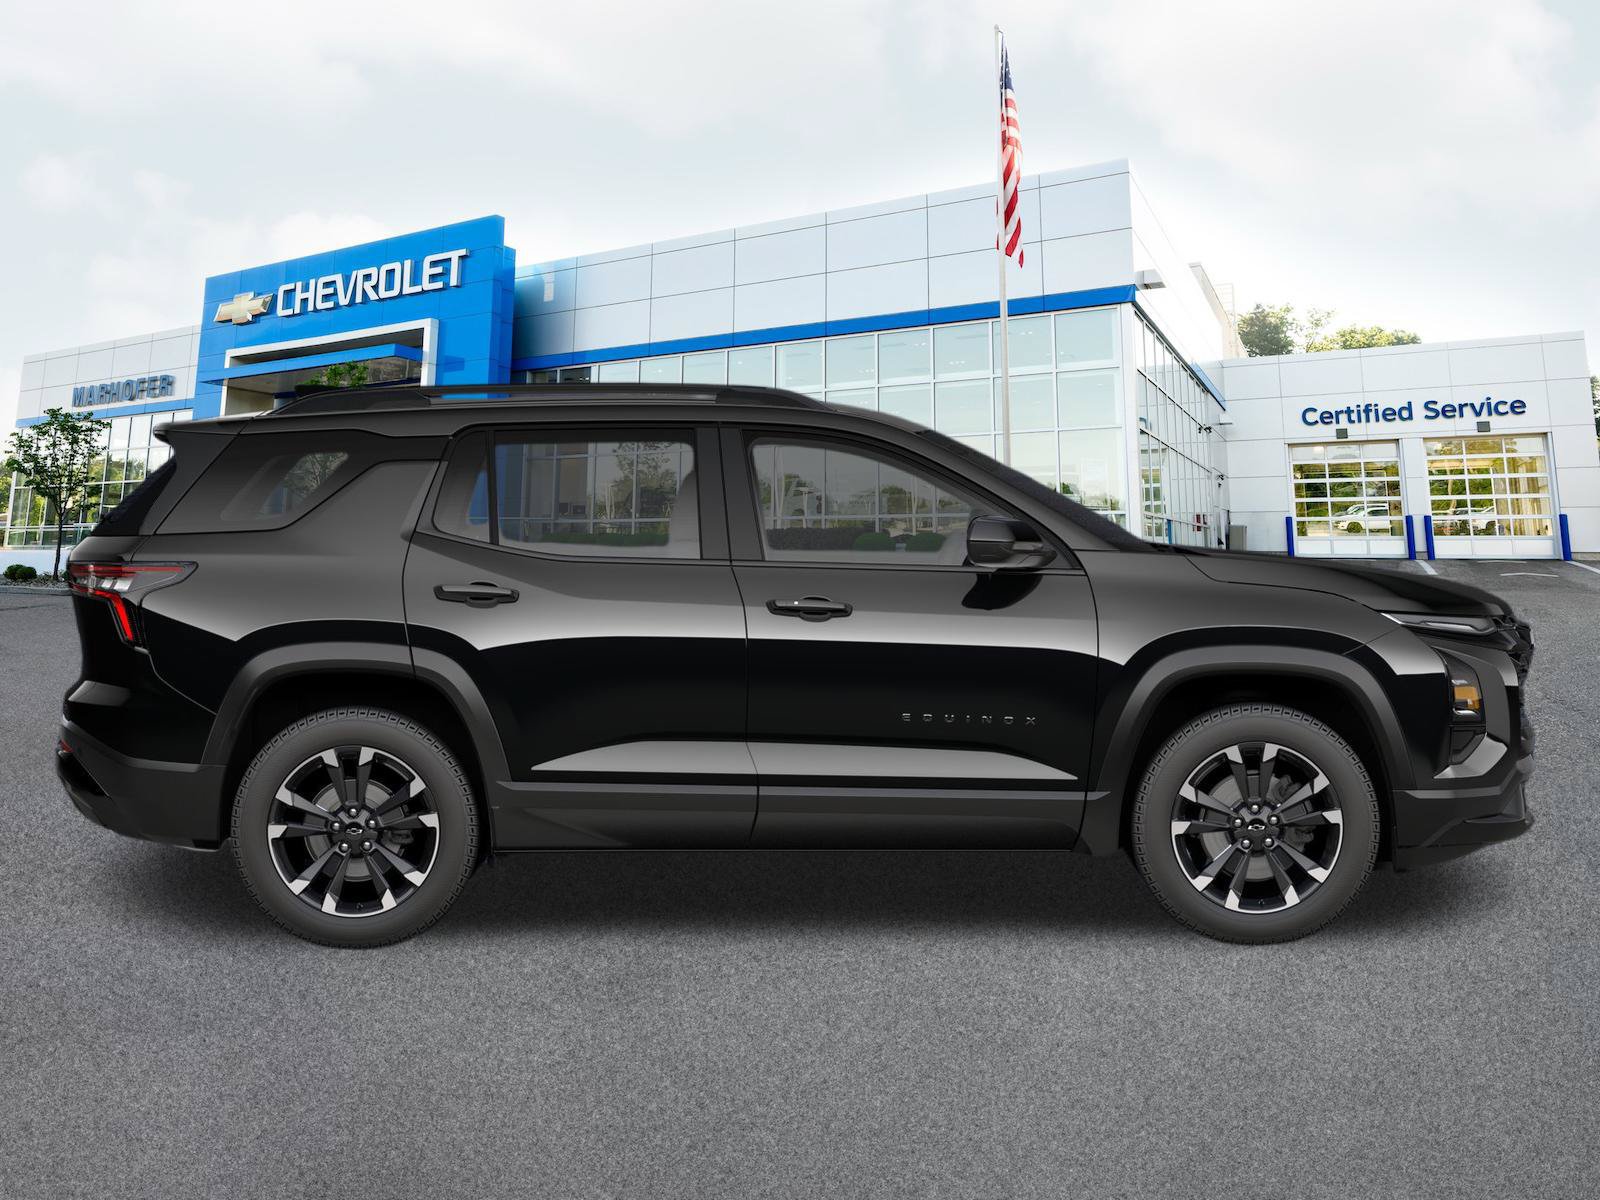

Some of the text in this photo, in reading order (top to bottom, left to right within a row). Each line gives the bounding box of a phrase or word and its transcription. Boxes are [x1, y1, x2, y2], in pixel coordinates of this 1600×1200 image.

[277, 248, 470, 317] CHEVROLET
[72, 374, 175, 408] MARHOFER
[1301, 397, 1527, 426] Certified Service
[901, 712, 1037, 726] EQUINOX
